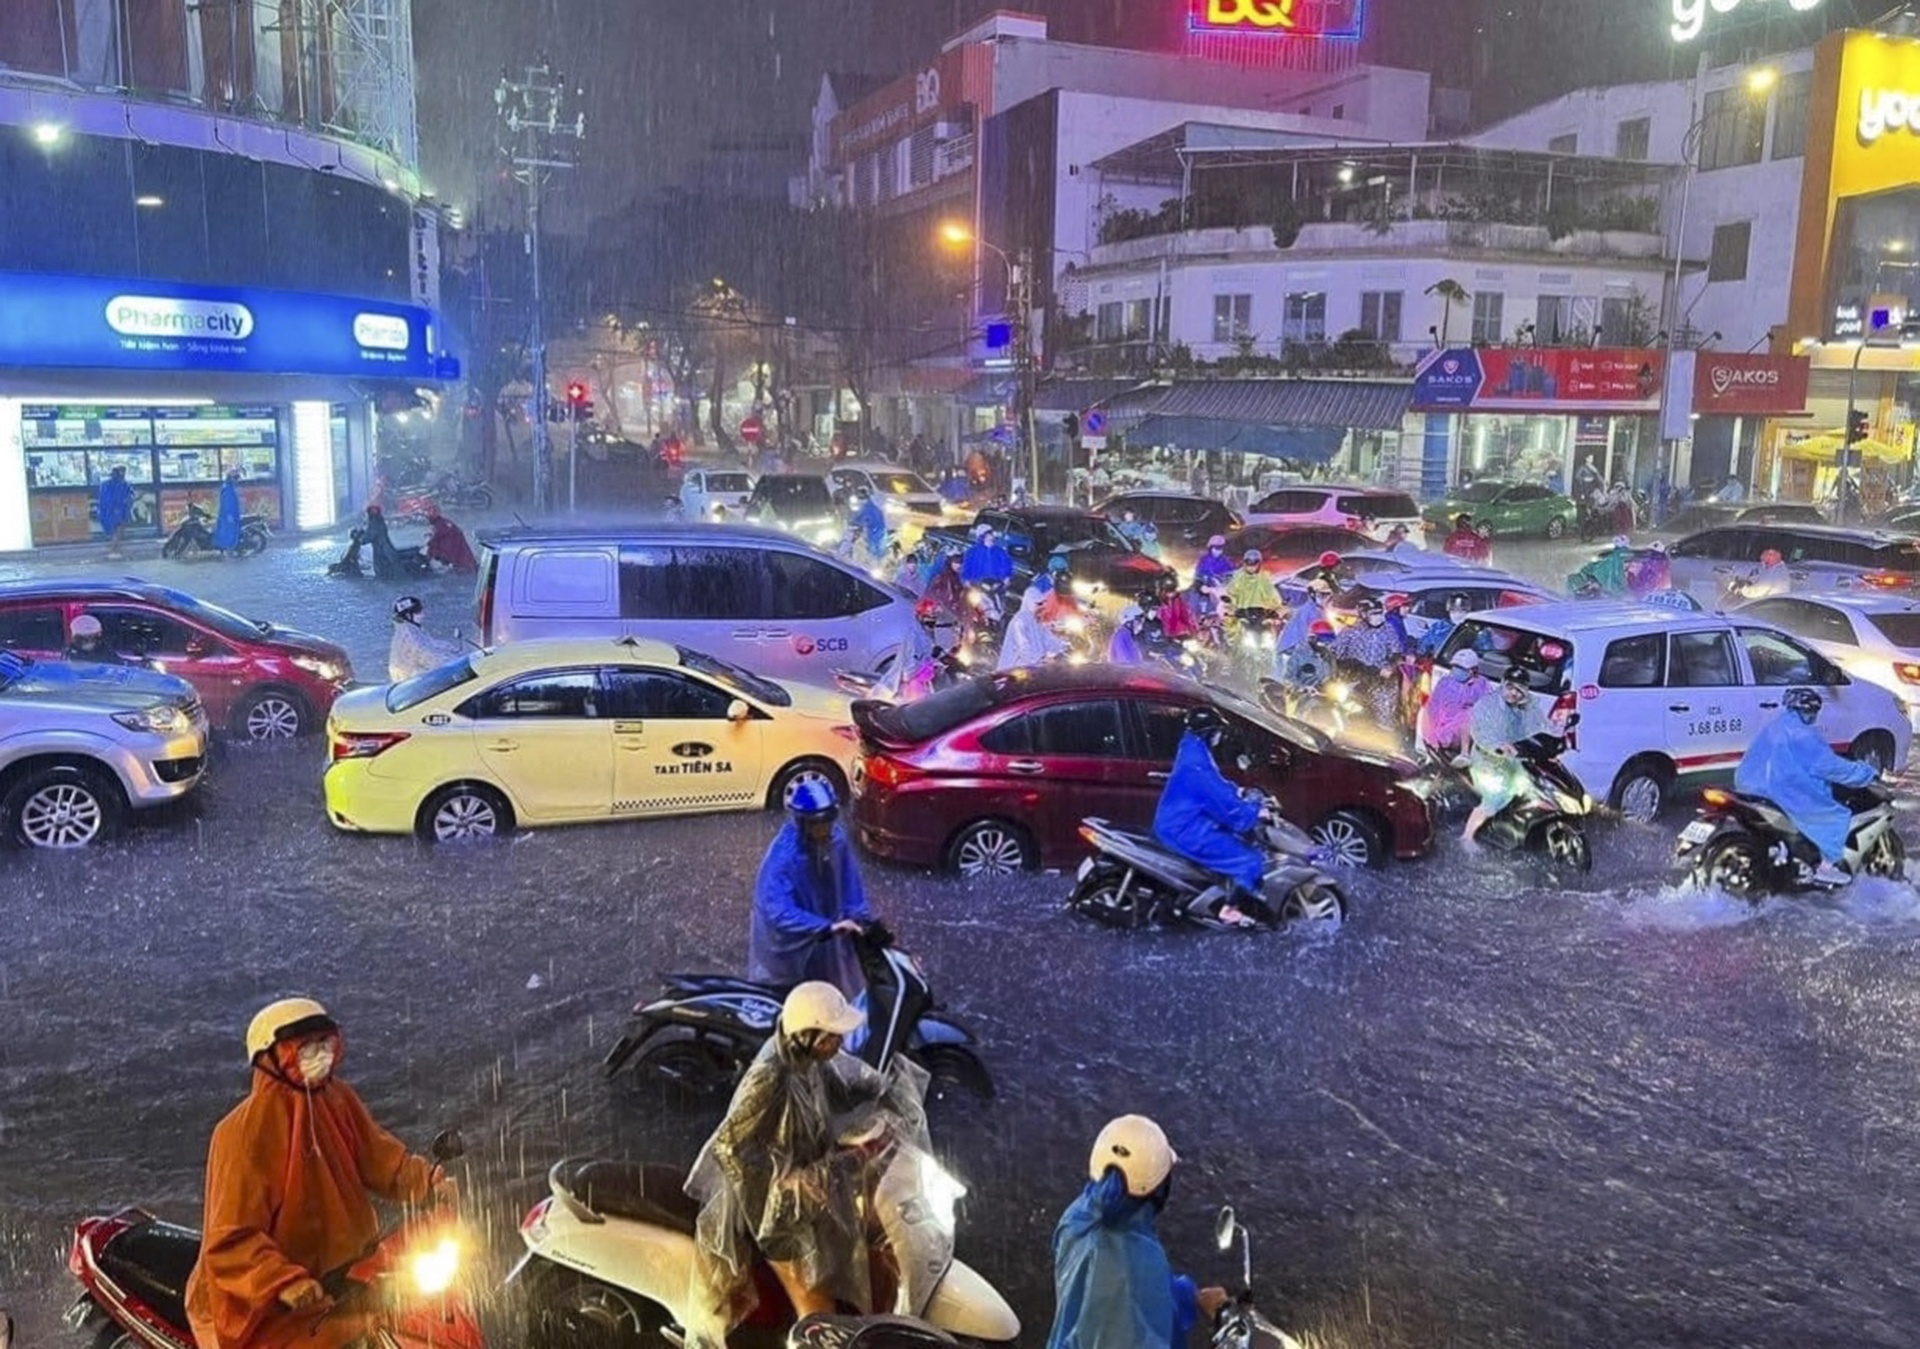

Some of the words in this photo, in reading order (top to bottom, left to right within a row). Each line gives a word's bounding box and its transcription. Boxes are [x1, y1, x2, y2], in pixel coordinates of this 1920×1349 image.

[117, 306, 244, 336] Pharmacity
[1427, 375, 1473, 385] SAKOS
[1713, 368, 1779, 386] SAKOS
[816, 637, 849, 652] SCB
[654, 764, 680, 774] TAXI
[715, 761, 733, 773] SA
